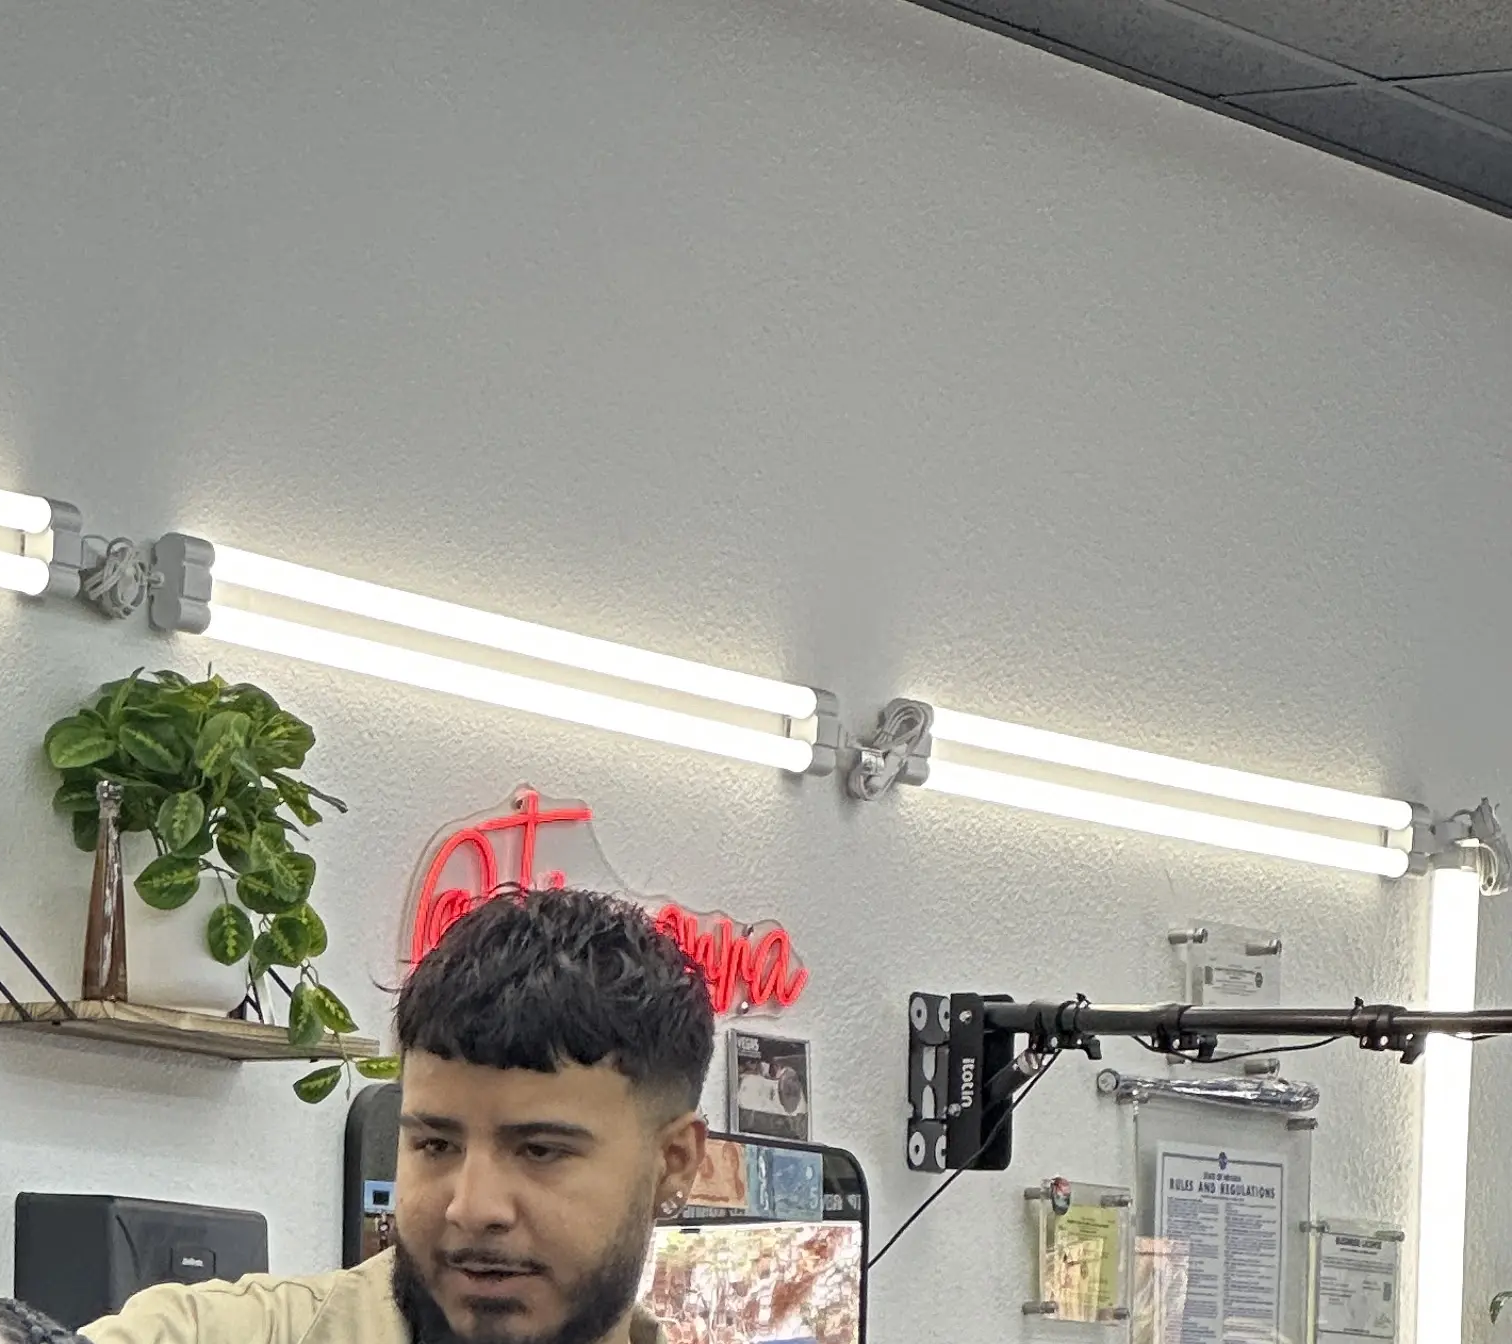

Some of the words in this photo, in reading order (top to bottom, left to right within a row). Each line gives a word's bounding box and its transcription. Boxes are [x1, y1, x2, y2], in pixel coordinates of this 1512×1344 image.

[961, 1058, 975, 1108] itotin
[1170, 1178, 1194, 1192] RULES
[1198, 1182, 1216, 1194] AND
[1220, 1183, 1276, 1200] REGULATIONS
